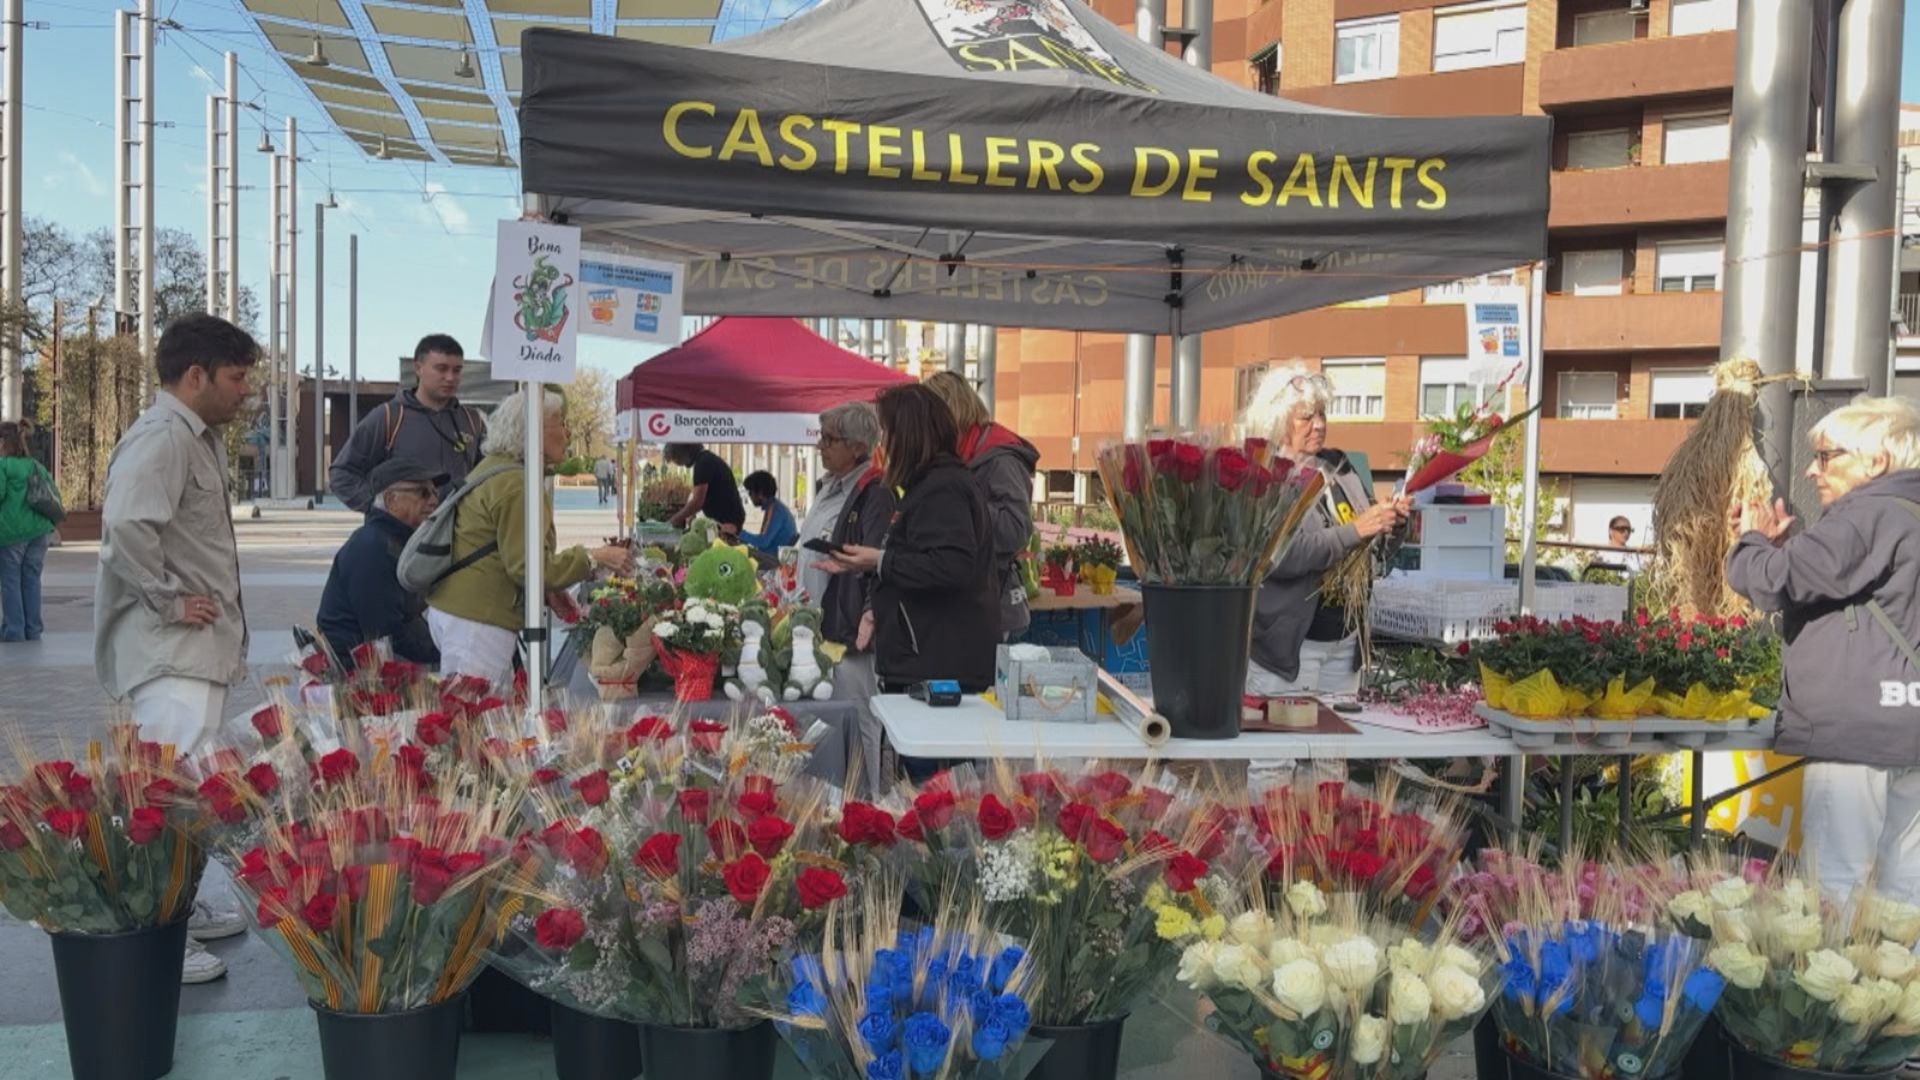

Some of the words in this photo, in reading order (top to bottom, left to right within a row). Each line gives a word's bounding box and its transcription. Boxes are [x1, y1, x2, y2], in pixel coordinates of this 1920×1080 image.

[662, 100, 1104, 193] CASTELLERS
[1131, 146, 1218, 202] DE
[1239, 149, 1448, 210] SANTS
[528, 235, 561, 256] Bona
[520, 345, 562, 363] Diada
[674, 413, 734, 426] Barcelona
[695, 427, 708, 437] en
[711, 425, 746, 437] comú
